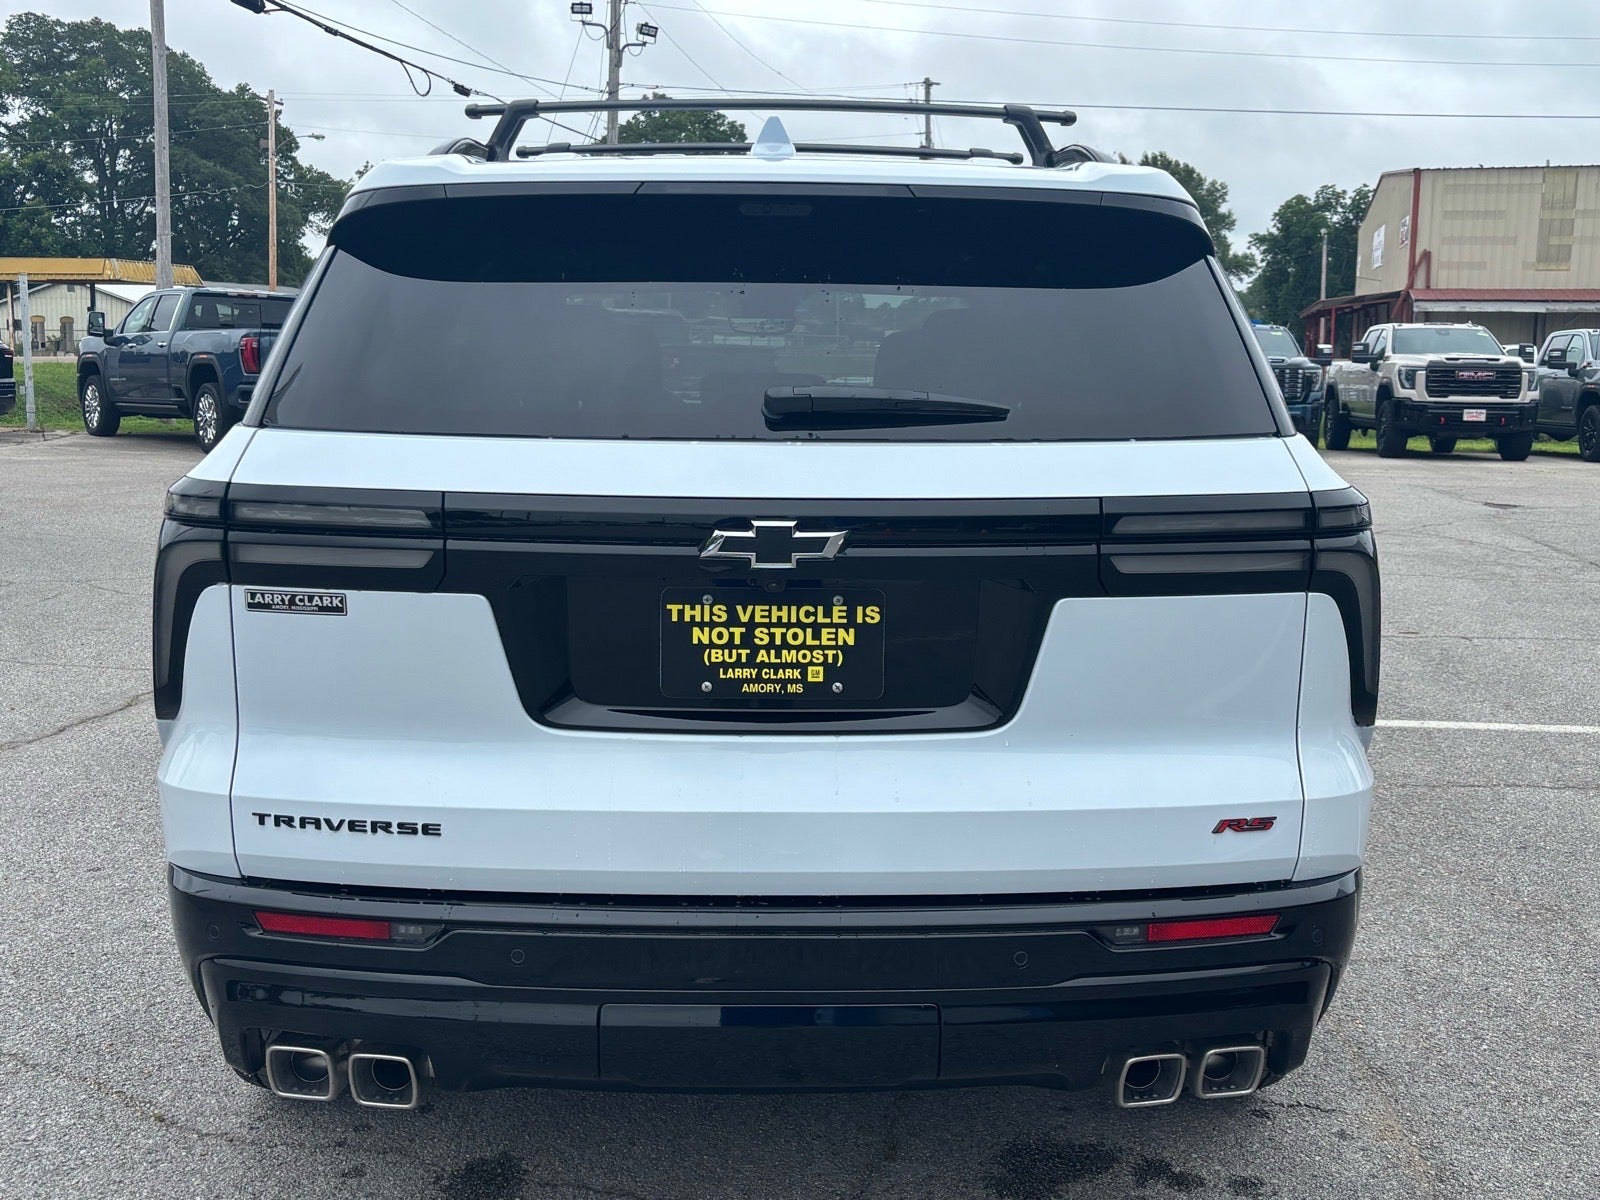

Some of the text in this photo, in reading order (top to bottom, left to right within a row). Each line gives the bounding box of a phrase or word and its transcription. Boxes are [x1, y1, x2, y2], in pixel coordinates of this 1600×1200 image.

[247, 592, 343, 607] LARRY CLARK
[666, 604, 881, 624] THIS VEHICLE IS
[692, 626, 855, 646] NOT STOLEN
[703, 649, 844, 667] (BUT ALMOST)
[719, 667, 802, 680] LARRY CLARK
[741, 683, 804, 694] AMORY, MS
[251, 812, 442, 837] TRAVERSE
[1211, 816, 1278, 834] RS
